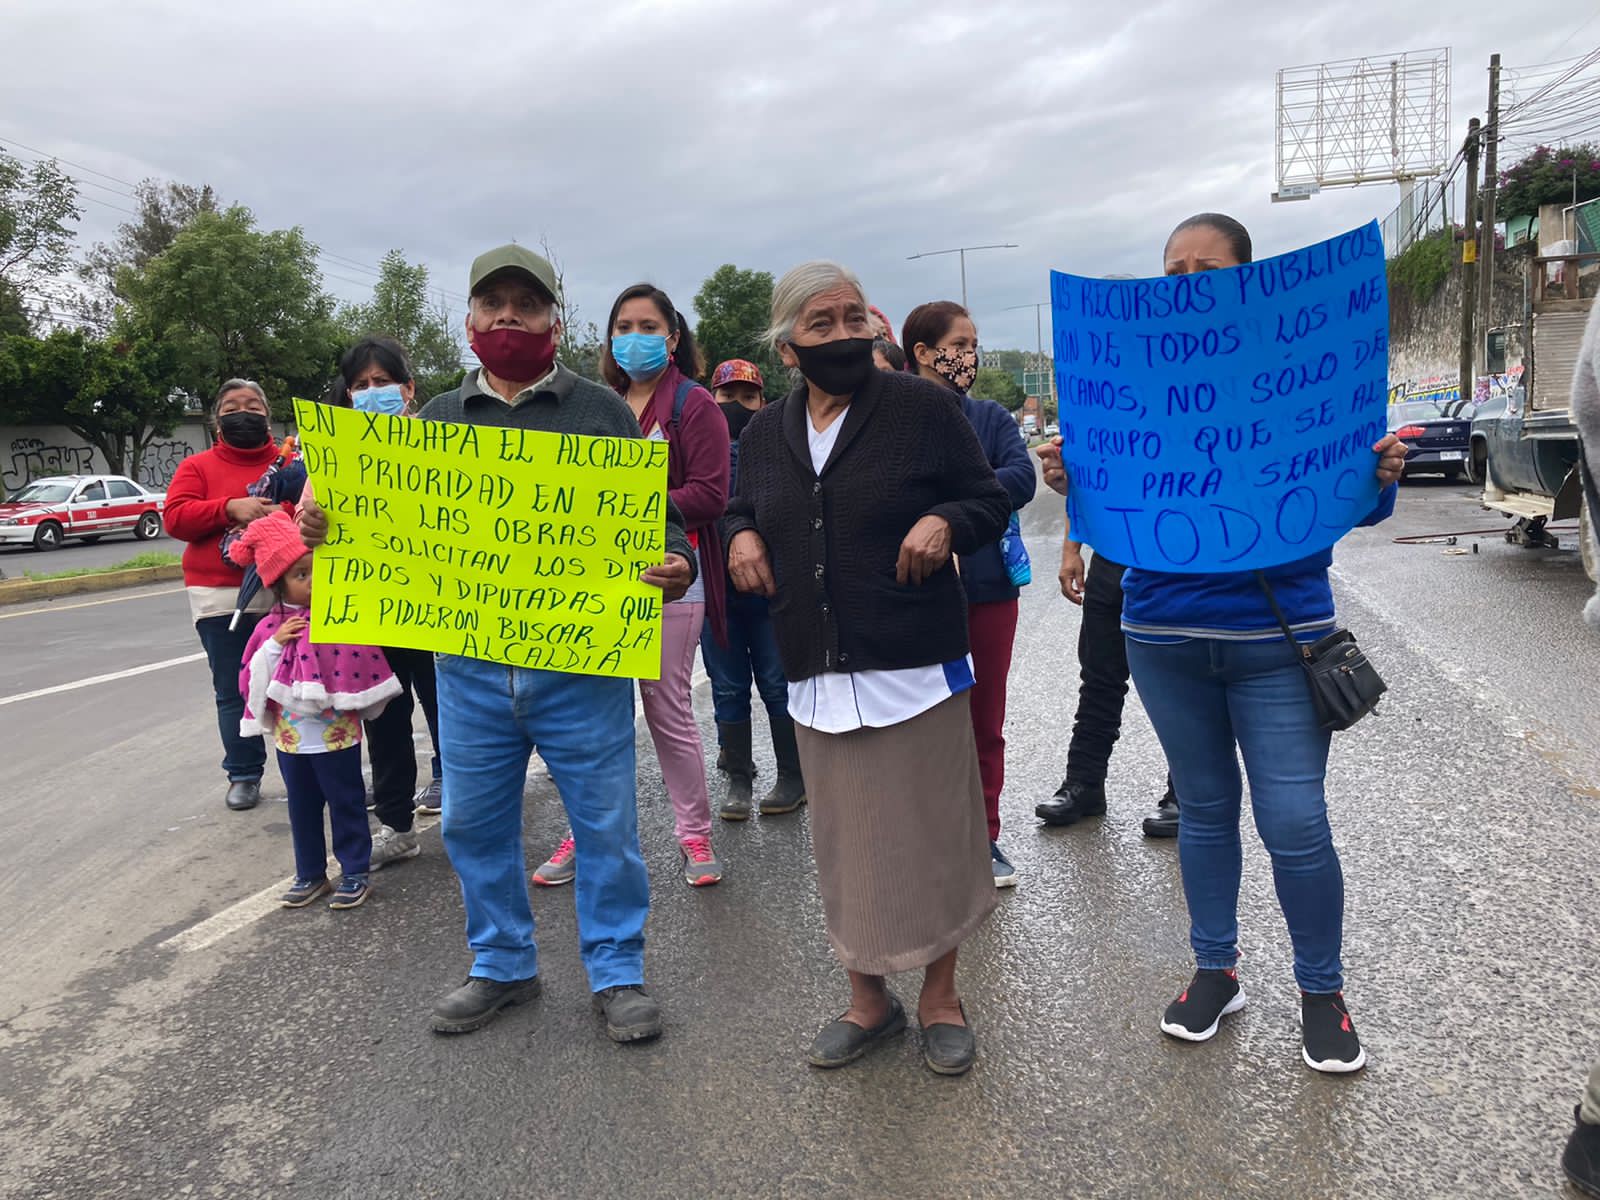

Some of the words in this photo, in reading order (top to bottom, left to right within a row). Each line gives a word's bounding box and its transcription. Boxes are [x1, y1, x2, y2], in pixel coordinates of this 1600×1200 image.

[1081, 272, 1216, 322] RECURSOS
[1237, 226, 1382, 304] PUBLICOS
[1087, 329, 1121, 369] DE
[1136, 324, 1241, 368] TODOS
[1275, 303, 1328, 344] LOS
[1347, 276, 1383, 321] ME
[1168, 383, 1216, 416] NO
[1354, 328, 1387, 371] DE
[297, 403, 335, 437] EN
[360, 410, 479, 458] XALAPA
[499, 428, 534, 463] EL
[556, 435, 667, 468] ALCALDE
[1087, 427, 1161, 460] GRUPO
[1194, 423, 1272, 464] QUE
[1295, 402, 1335, 434] SE
[304, 442, 338, 478] DA
[359, 453, 515, 509] PRIORIDAD
[531, 483, 575, 514] EN
[597, 490, 661, 522] REA
[1143, 468, 1222, 499] PARA
[419, 503, 470, 535] LAS
[494, 517, 597, 548] OBRAS
[614, 528, 662, 555] QUE
[1104, 468, 1358, 566] TODOS
[370, 530, 511, 576] SOLICITAN
[533, 556, 586, 579] LOS
[602, 557, 662, 582] DIP
[318, 556, 410, 587] TADOS
[428, 573, 443, 599] Y
[455, 577, 607, 617] DIPUTADAS
[619, 595, 662, 624] QUE
[323, 593, 360, 627] LE
[378, 597, 480, 632] PIDIERON
[498, 614, 594, 647] BUSCAR
[613, 625, 655, 651] LA
